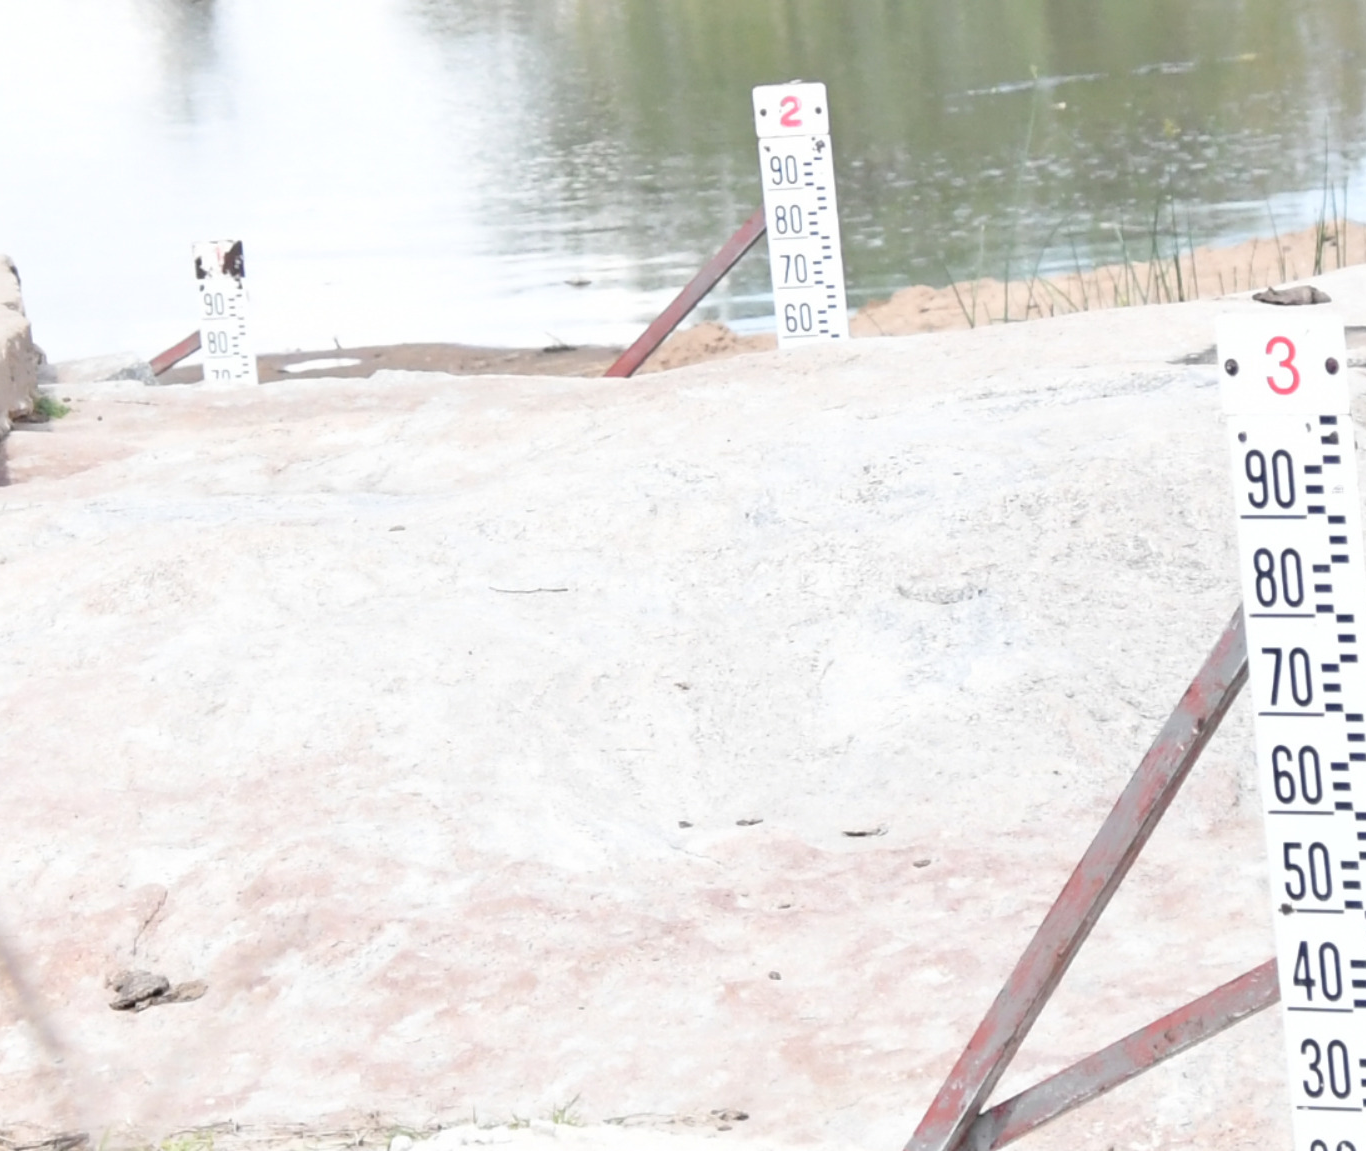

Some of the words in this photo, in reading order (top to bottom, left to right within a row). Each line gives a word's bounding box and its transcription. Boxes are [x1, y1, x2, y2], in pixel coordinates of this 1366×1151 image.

[780, 96, 802, 127] 2
[770, 155, 798, 185] 90
[775, 205, 803, 234] 80
[780, 254, 808, 283] 70
[204, 292, 224, 316] 90
[784, 303, 812, 333] 60
[208, 331, 228, 354] 80
[1265, 336, 1301, 396] 3
[1244, 449, 1296, 510] 90
[1253, 547, 1305, 608] 80
[1261, 646, 1313, 708] 70
[1271, 744, 1323, 806] 60
[1282, 841, 1333, 902] 50
[1292, 940, 1343, 1002] 40
[1300, 1038, 1352, 1100] 30
